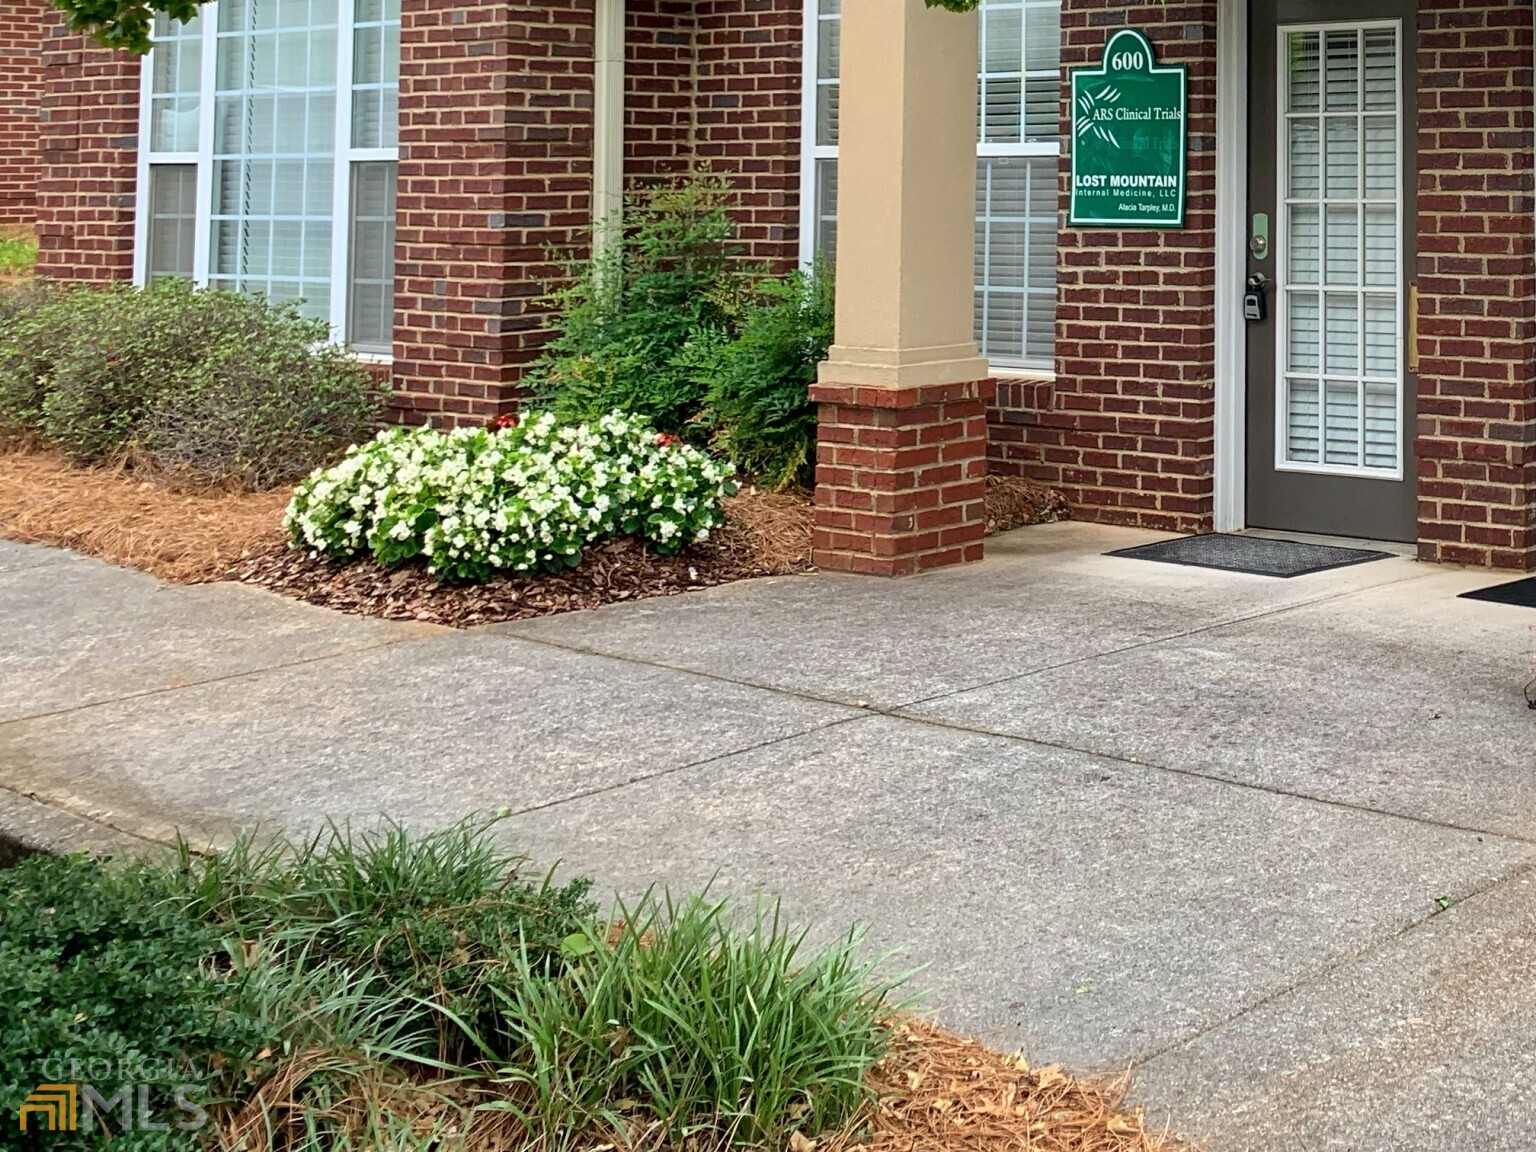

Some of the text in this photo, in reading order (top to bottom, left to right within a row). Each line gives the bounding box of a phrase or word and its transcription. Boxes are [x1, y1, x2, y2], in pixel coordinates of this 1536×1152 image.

[1111, 51, 1143, 70] 600
[1092, 107, 1181, 121] ARS Clinical Trials
[1076, 175, 1177, 187] LOST MOUNTAIN
[1075, 189, 1176, 198] Internal Medicine, LLC
